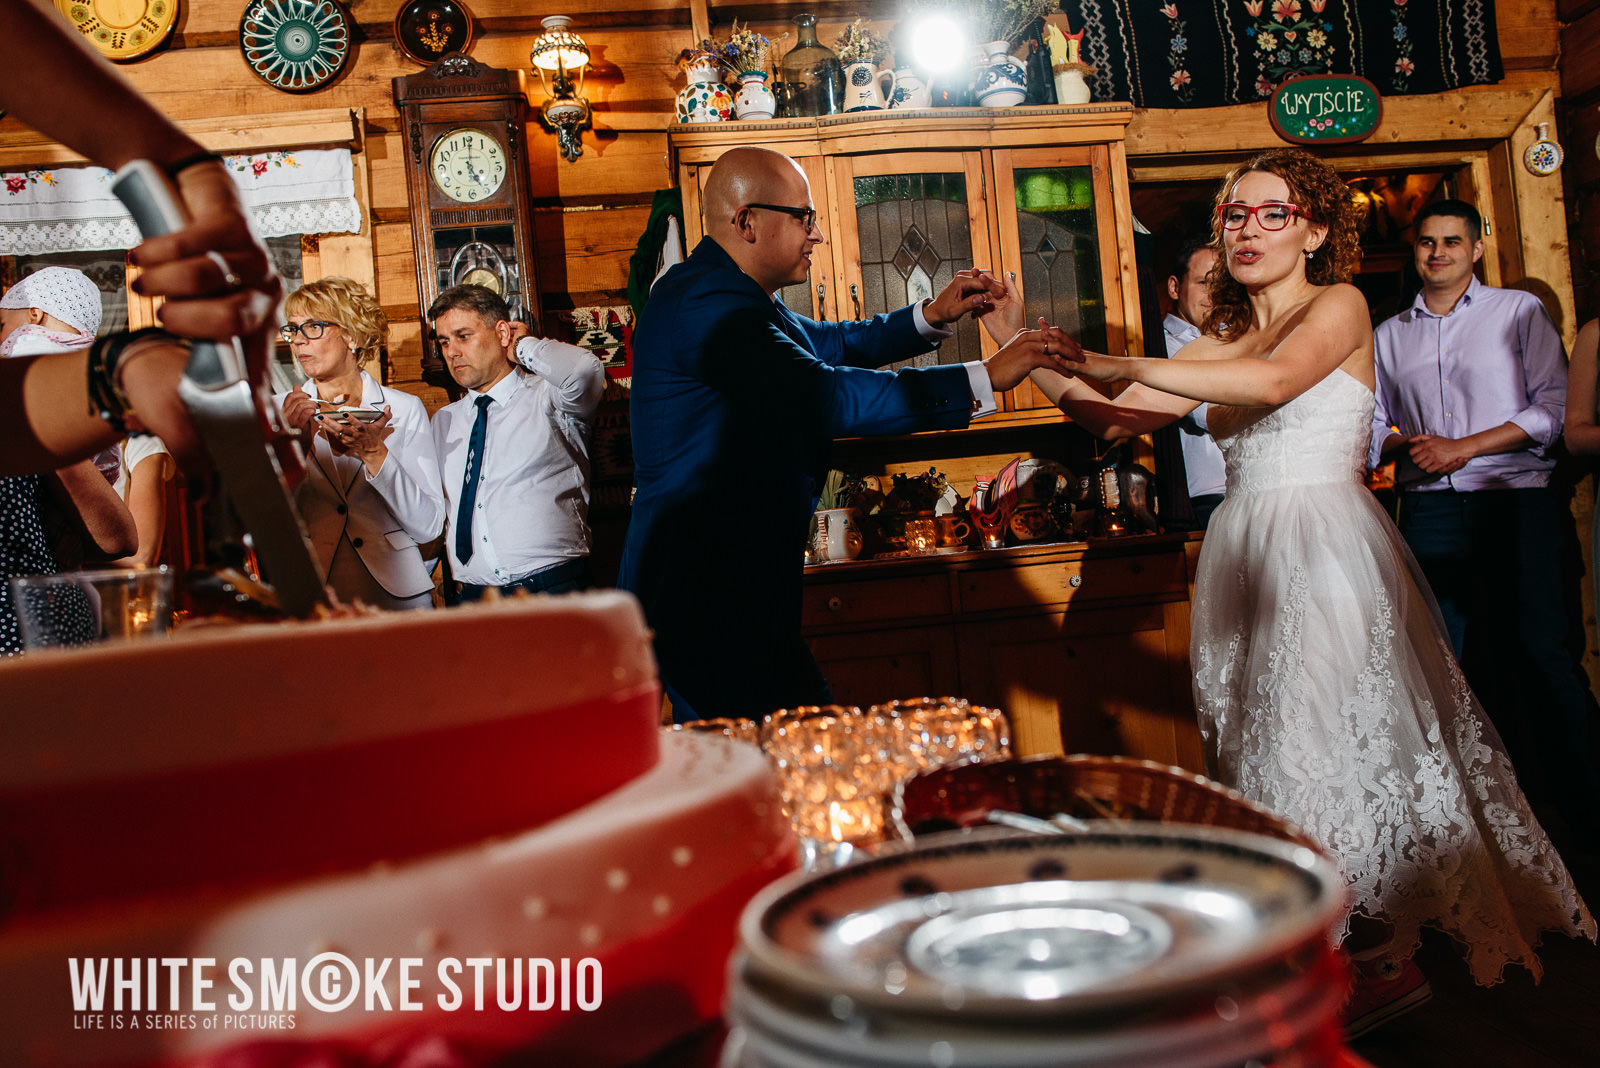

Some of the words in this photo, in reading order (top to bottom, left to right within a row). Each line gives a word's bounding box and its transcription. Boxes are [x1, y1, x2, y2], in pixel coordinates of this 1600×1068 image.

[1281, 86, 1365, 117] WYJŚCIE
[450, 140, 458, 151] 11
[440, 150, 451, 162] 10
[468, 188, 477, 199] 6
